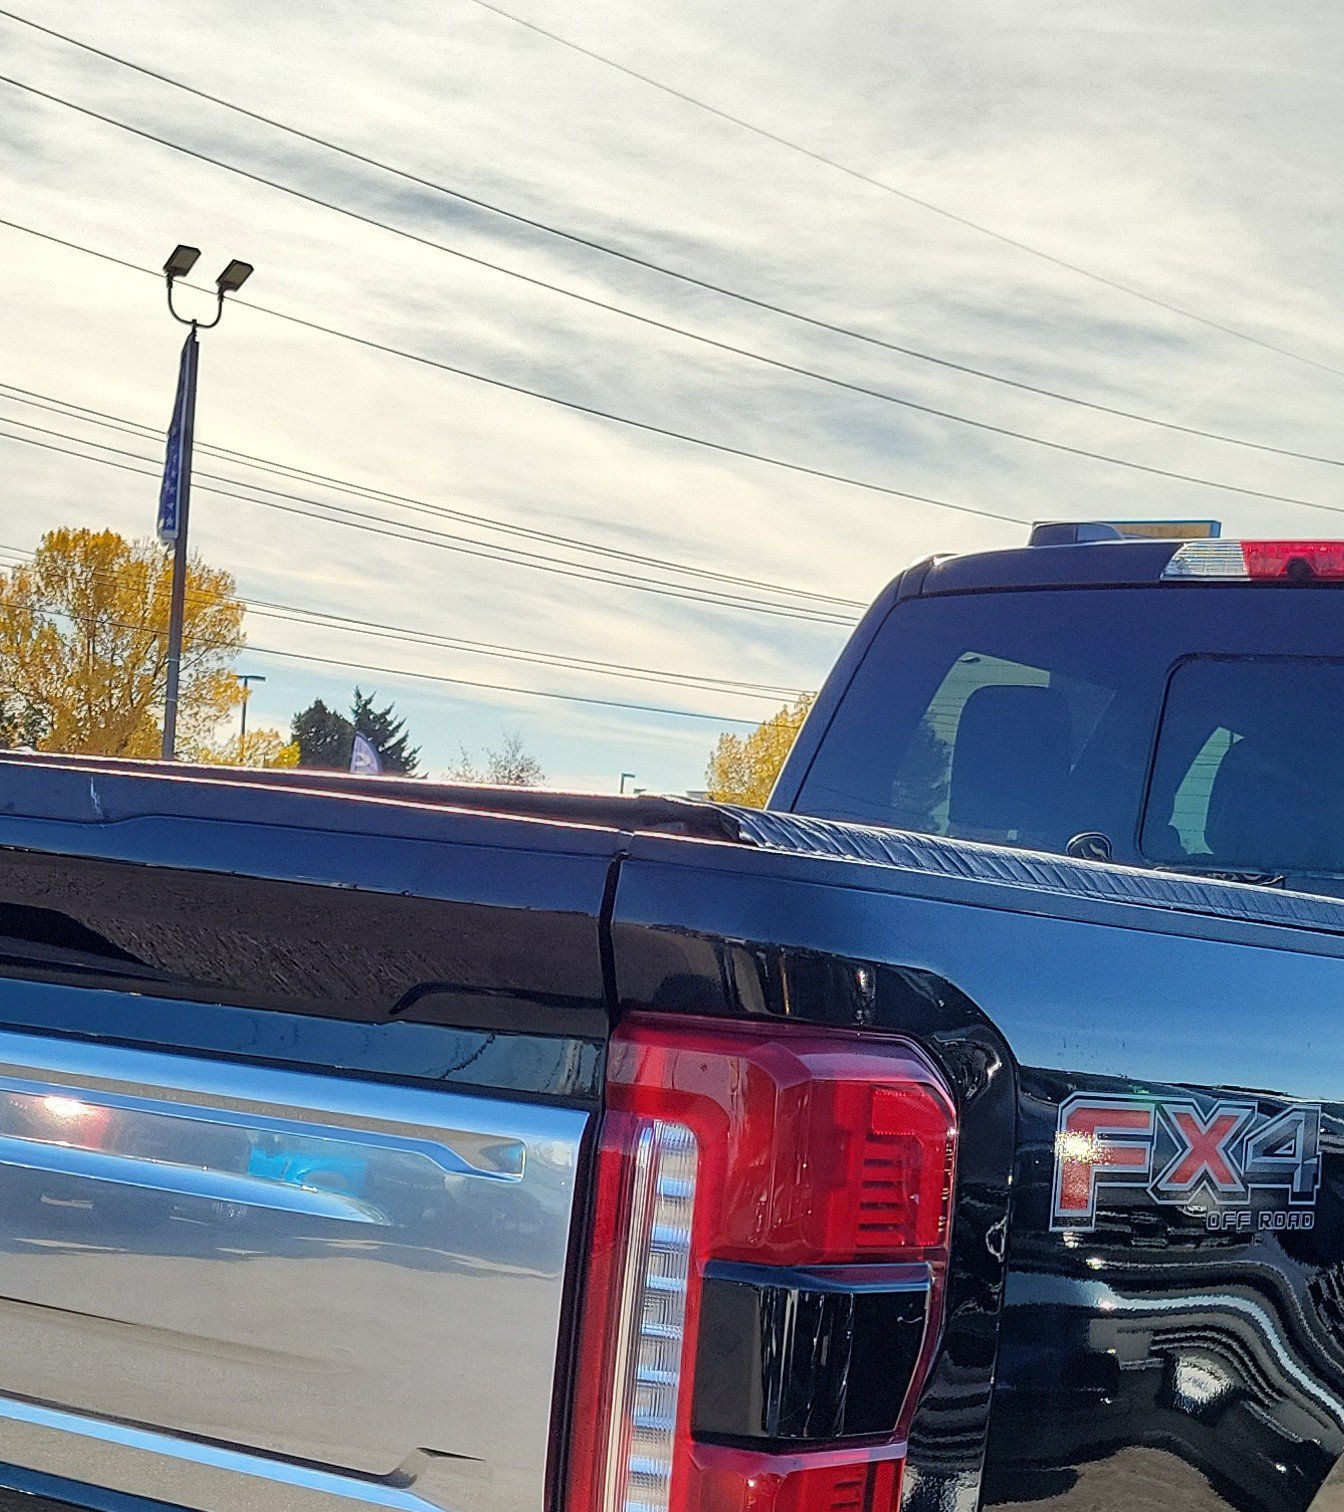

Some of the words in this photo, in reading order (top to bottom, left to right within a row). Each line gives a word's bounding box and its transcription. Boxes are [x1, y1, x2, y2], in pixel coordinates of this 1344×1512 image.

[1049, 1090, 1323, 1232] FX4
[1206, 1211, 1252, 1231] OFF
[1258, 1211, 1316, 1231] ROAD
